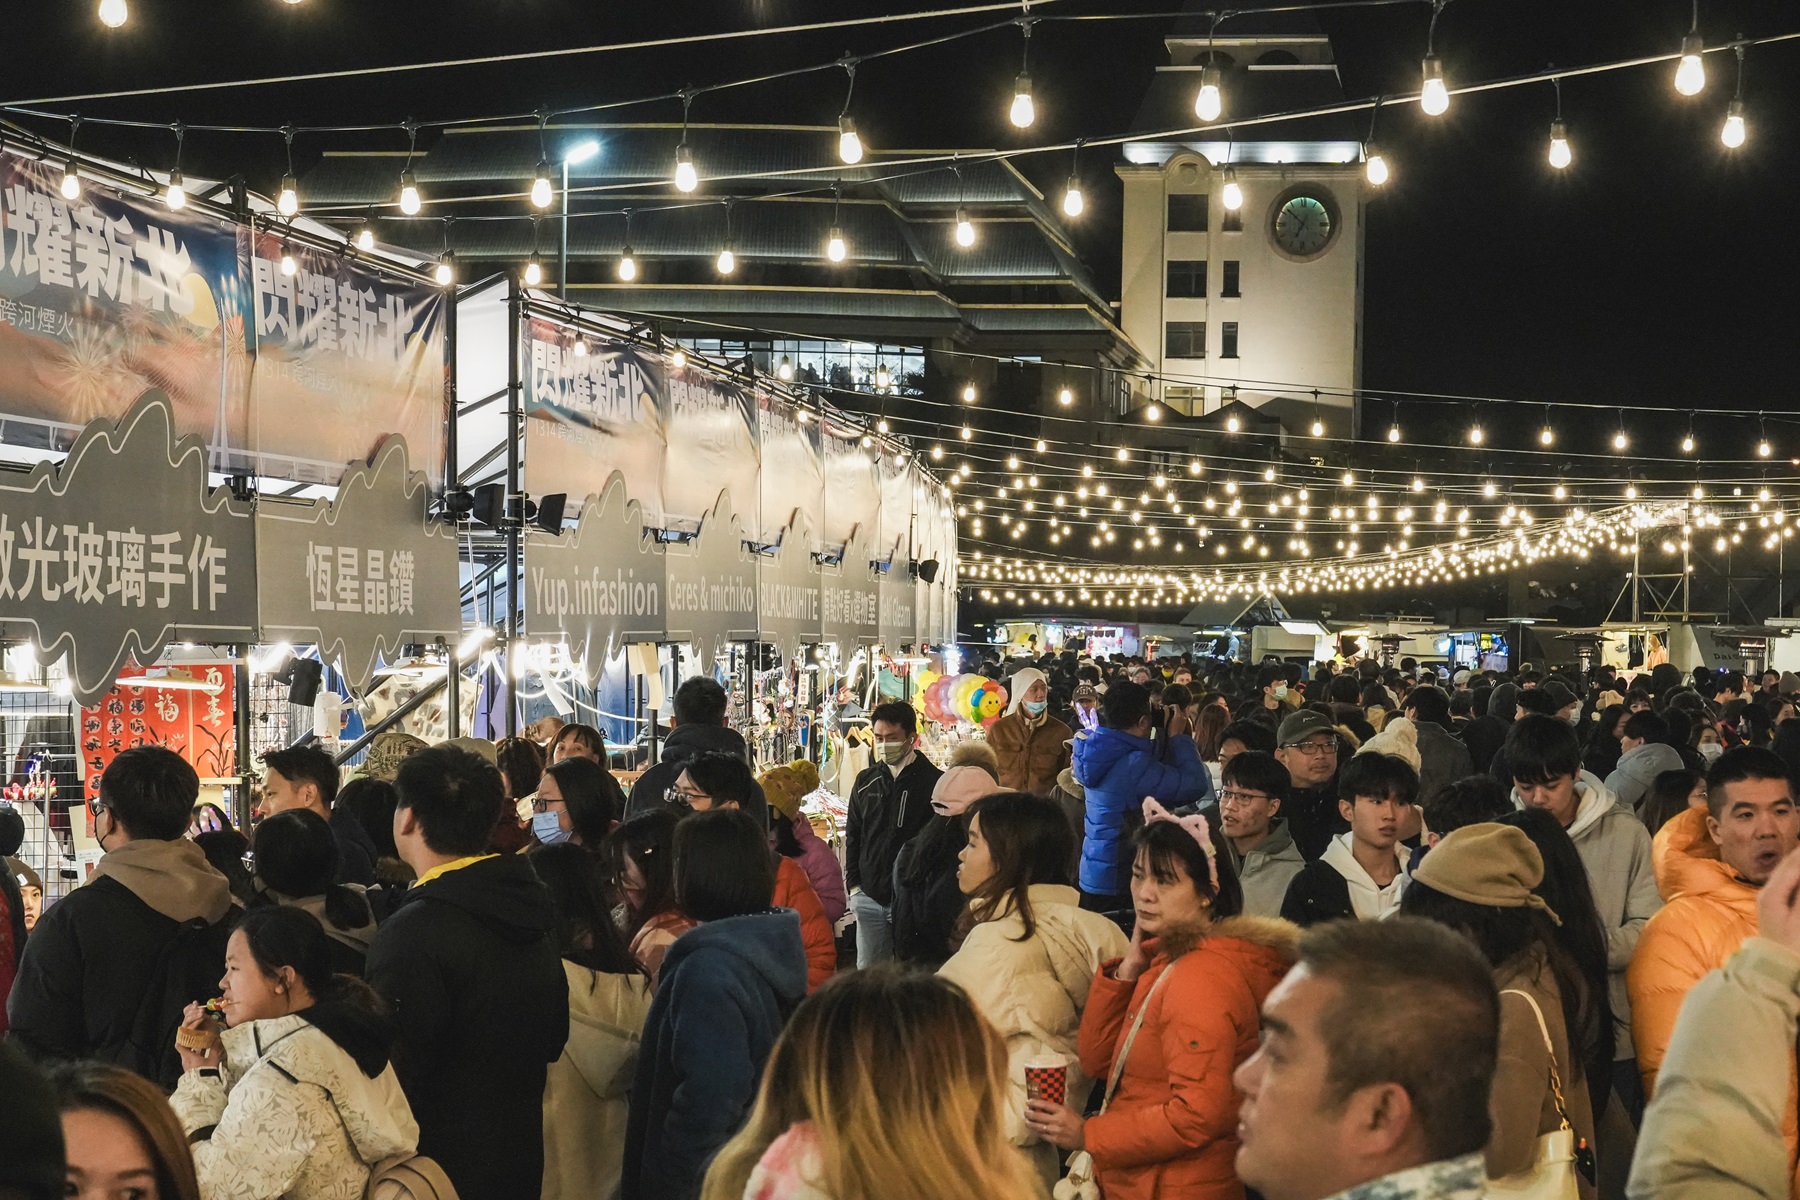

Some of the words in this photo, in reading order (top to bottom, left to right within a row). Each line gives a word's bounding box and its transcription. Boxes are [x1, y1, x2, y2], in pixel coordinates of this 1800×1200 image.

[0, 184, 195, 315] 耀新北
[306, 541, 415, 616] 恆星晶鑽
[532, 565, 658, 628] Yup.infashion
[668, 573, 698, 611] Ceres
[700, 575, 709, 611] &
[710, 574, 754, 612] michiko
[761, 582, 818, 626] BLACK&WHITE
